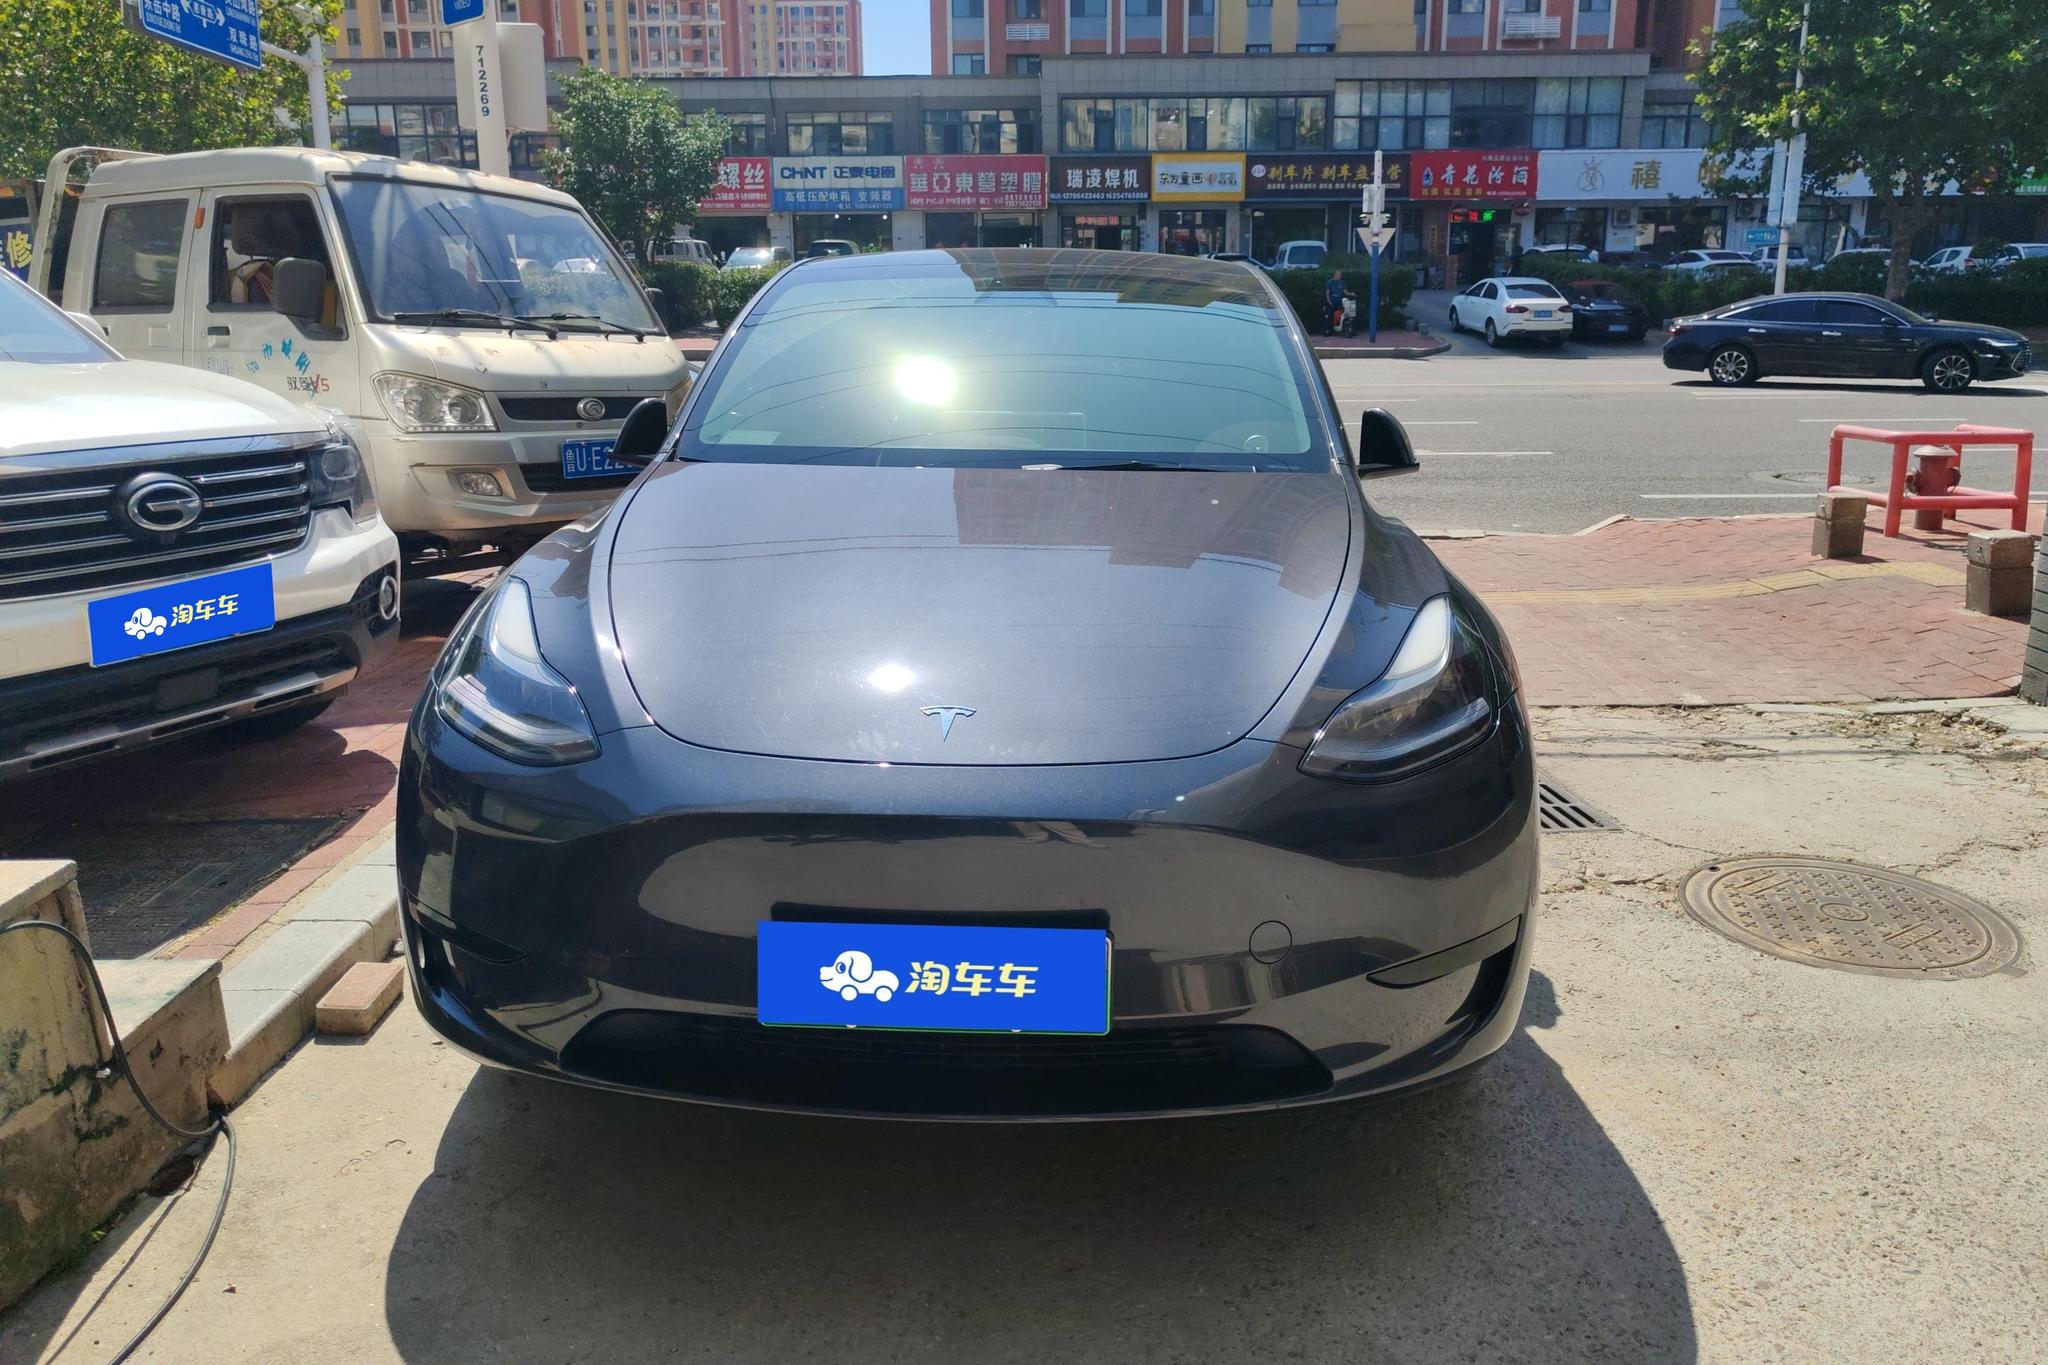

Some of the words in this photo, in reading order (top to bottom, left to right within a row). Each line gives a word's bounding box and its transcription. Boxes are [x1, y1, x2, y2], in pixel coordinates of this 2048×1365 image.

[228, 26, 258, 52] 双珠路
[475, 45, 490, 117] 712269
[718, 162, 765, 190] 螺丝
[780, 166, 827, 179] CHNT
[833, 166, 896, 179] 正泰电器
[1066, 168, 1140, 189] 瑞凌焊机
[1267, 164, 1314, 181] 刹车片
[1441, 163, 1529, 186] 青花汾酒
[784, 191, 850, 202] 高低压配电箱
[857, 190, 892, 202] 变频器
[0, 230, 33, 268] 修
